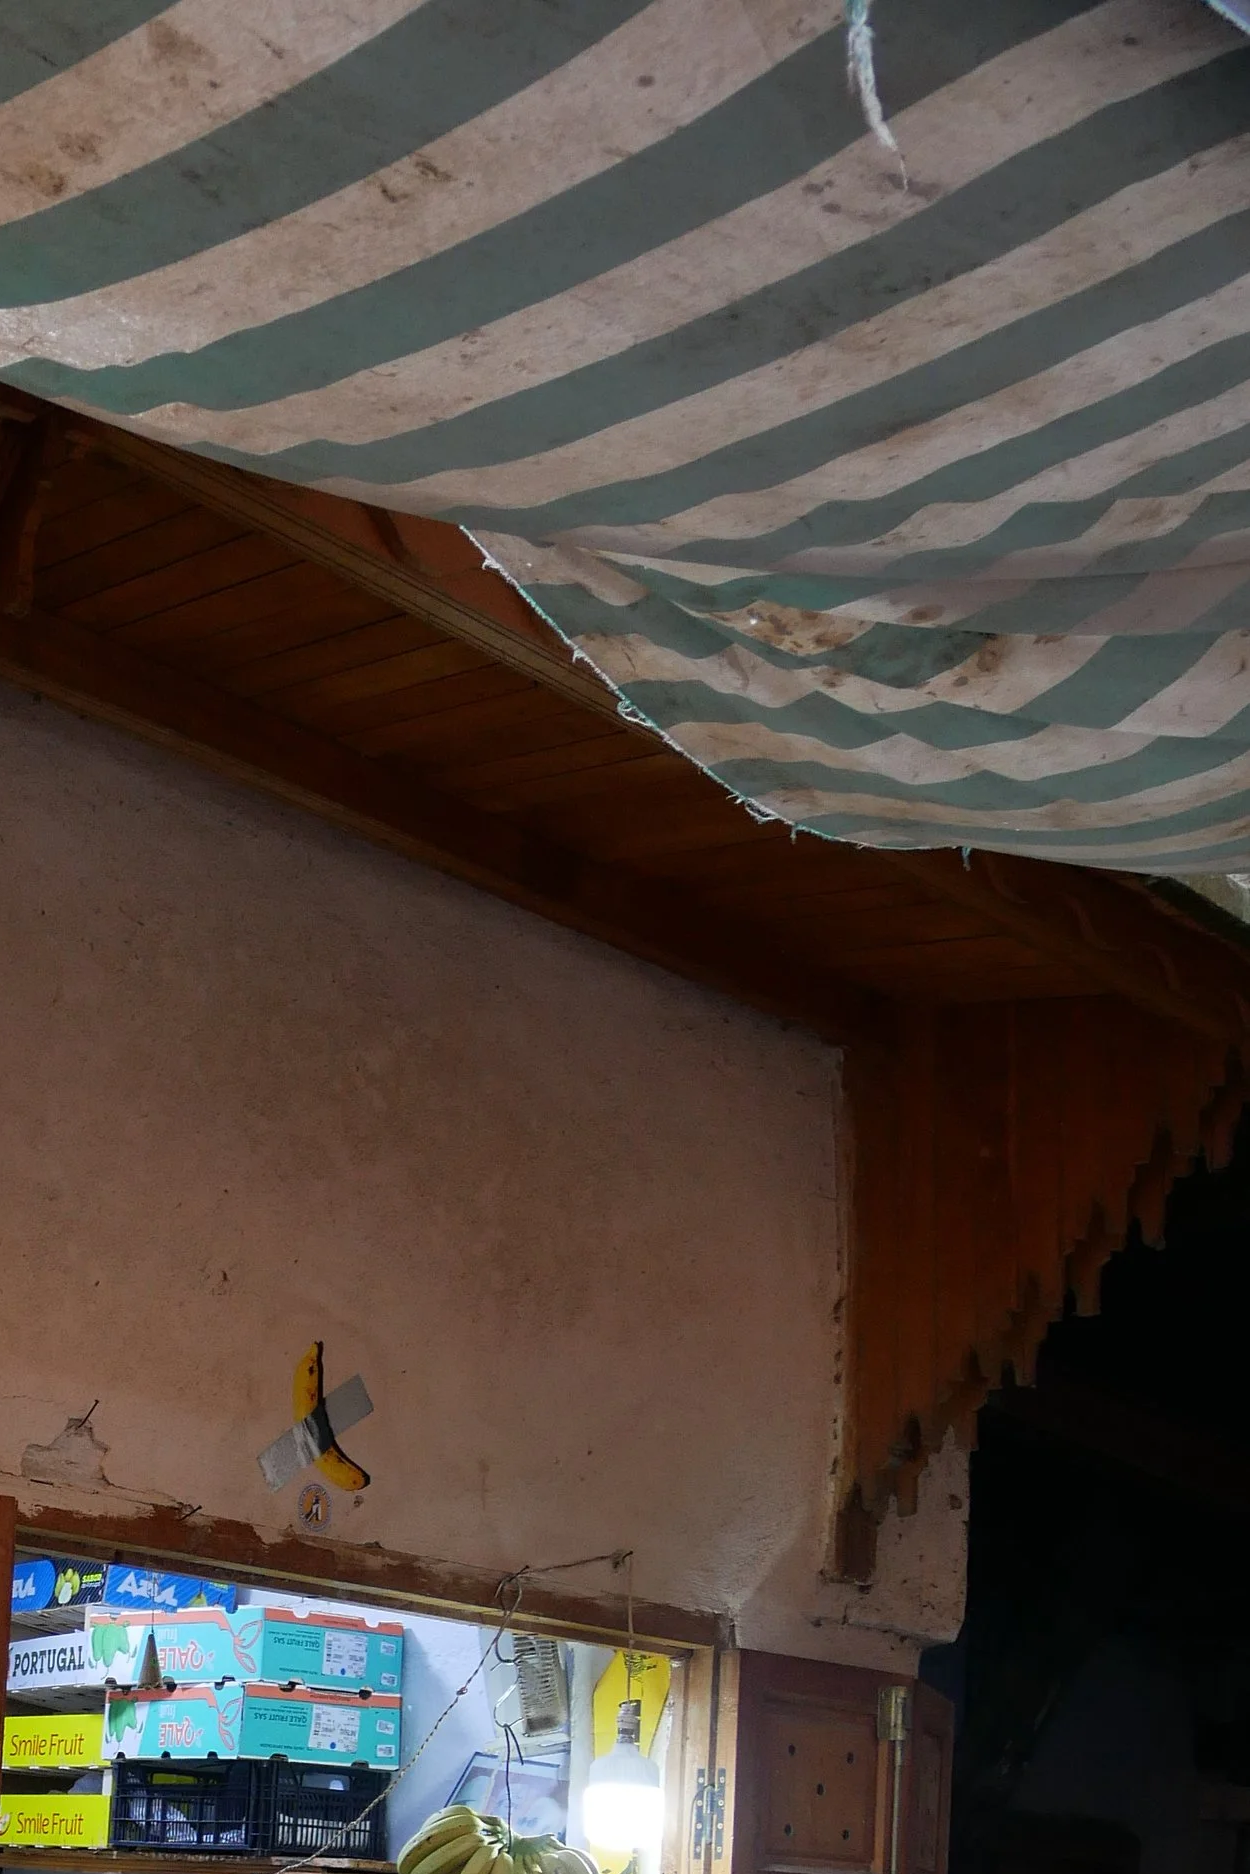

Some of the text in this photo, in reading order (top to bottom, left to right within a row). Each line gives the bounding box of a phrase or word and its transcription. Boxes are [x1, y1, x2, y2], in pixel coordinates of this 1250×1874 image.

[12, 1645, 85, 1677] PORTUGAL
[253, 1712, 268, 1721] SAS
[158, 1716, 196, 1747] QALE
[10, 1733, 85, 1757] Smile Fruit
[16, 1812, 84, 1836] Smile Fruit
